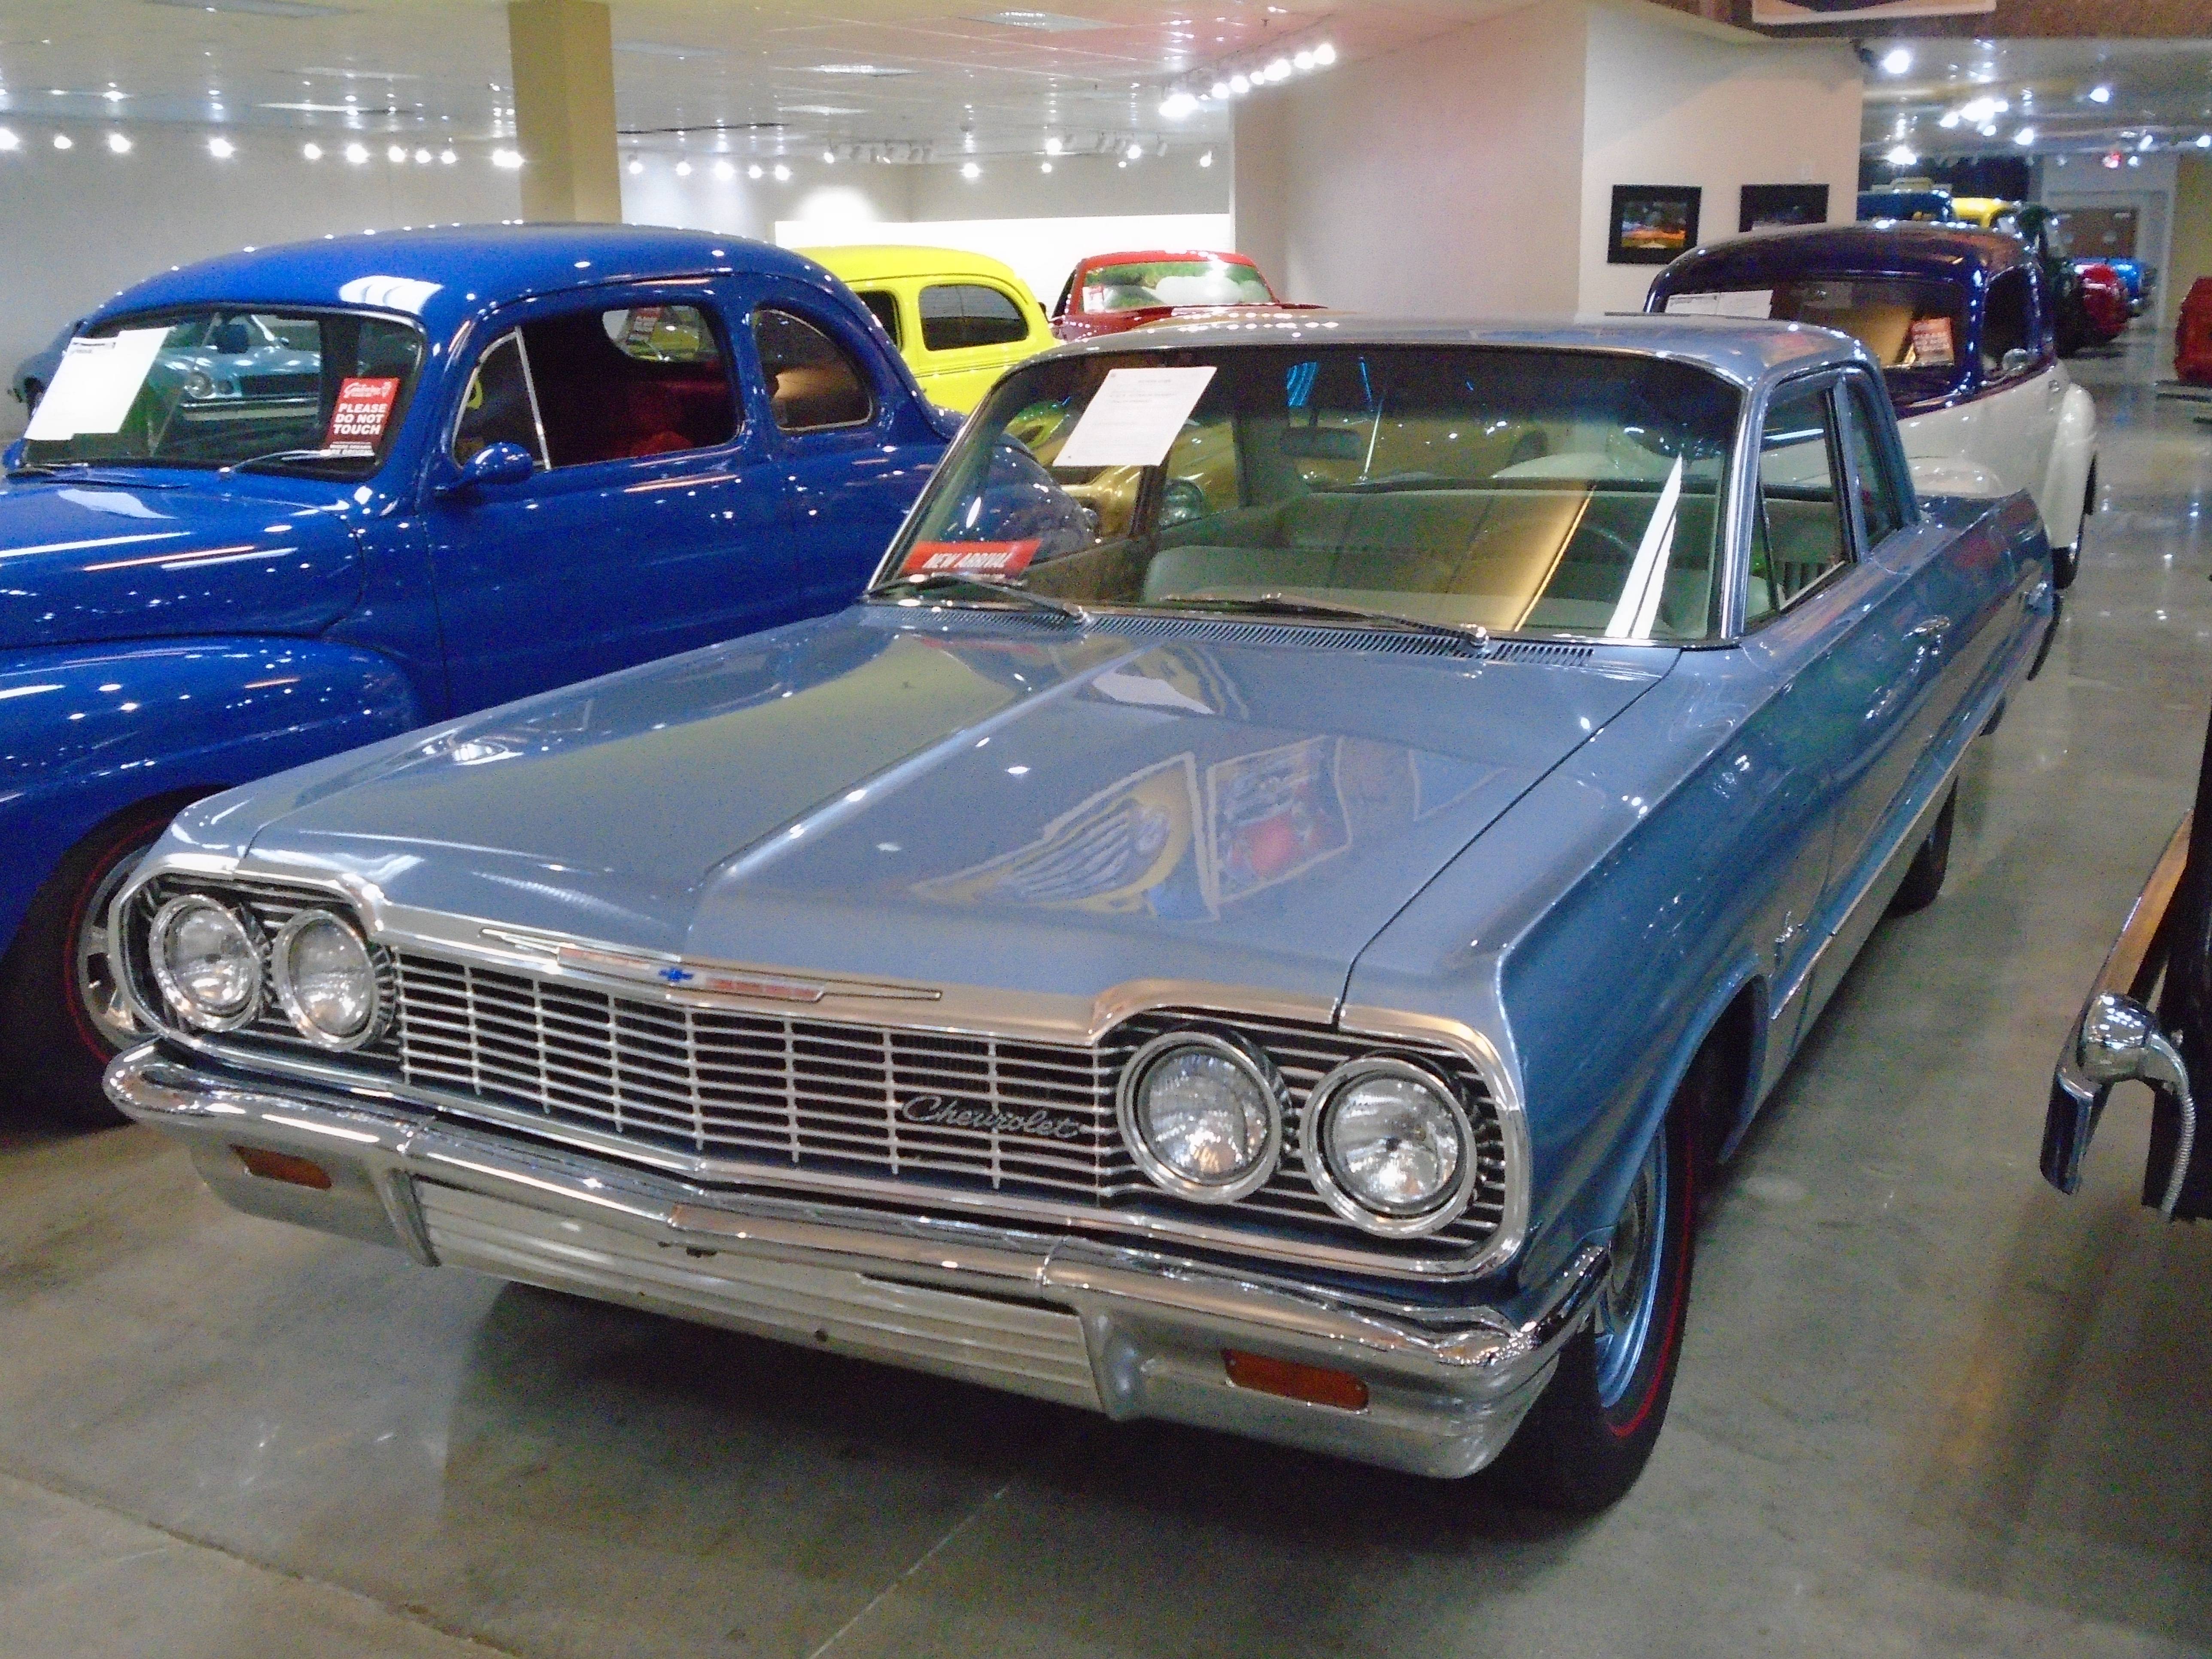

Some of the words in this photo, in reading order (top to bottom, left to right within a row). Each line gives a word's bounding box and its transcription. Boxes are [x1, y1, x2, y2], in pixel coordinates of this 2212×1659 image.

[338, 403, 387, 413] PLEASE
[334, 413, 355, 423] DO
[356, 413, 384, 423] NOT
[333, 424, 381, 435] TOUCH
[902, 1094, 1079, 1138] Chevrolet
